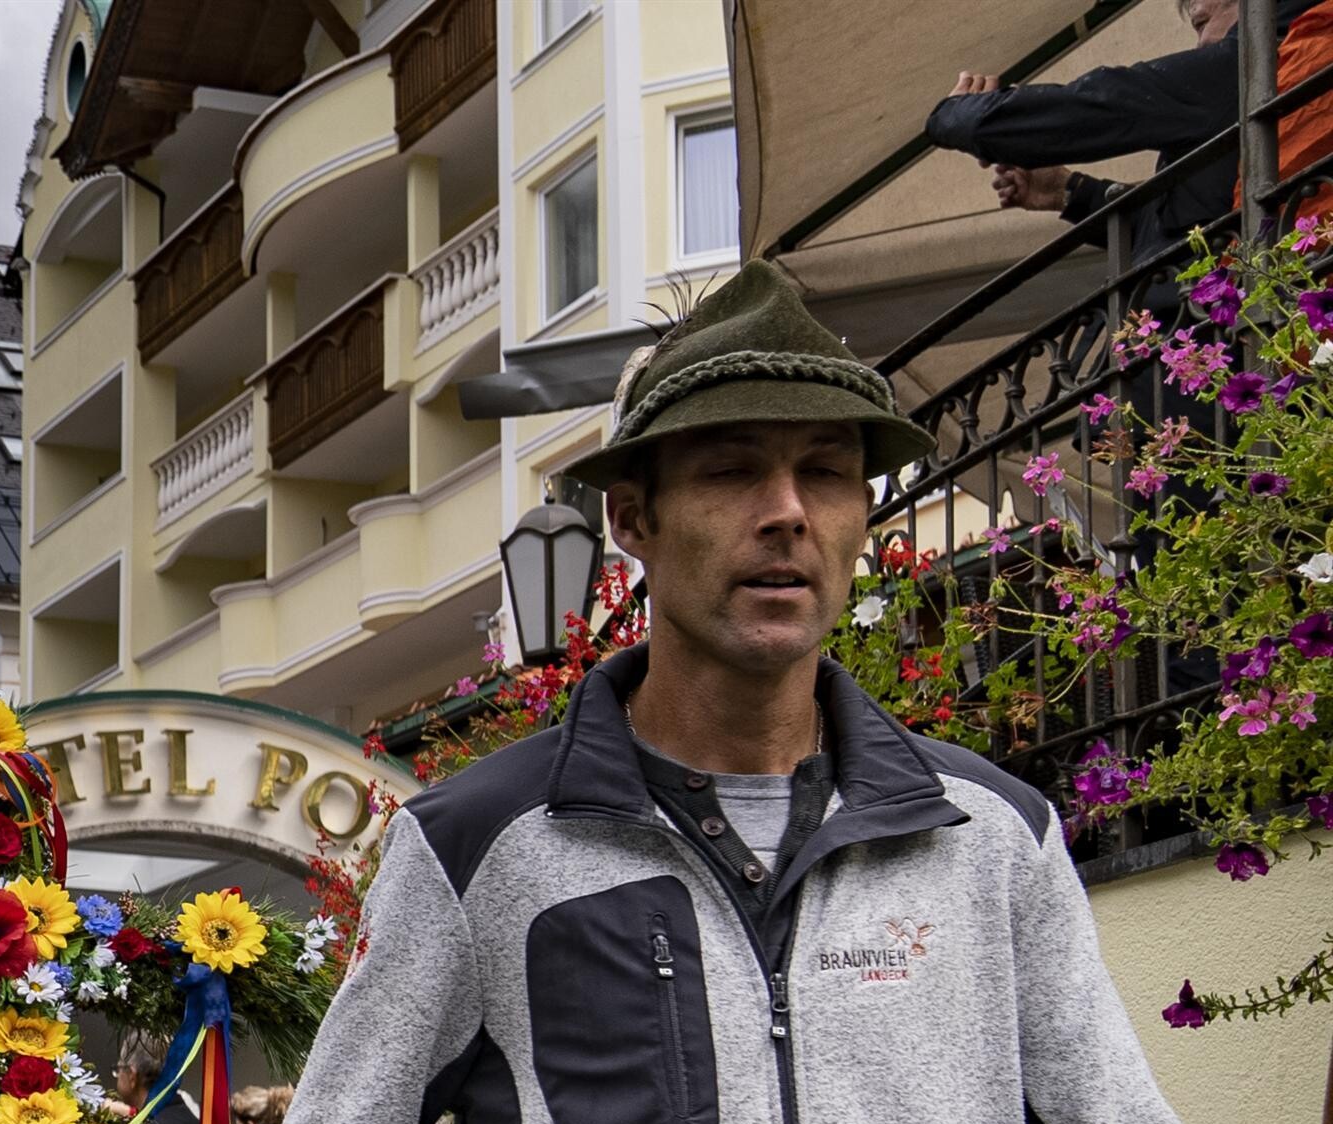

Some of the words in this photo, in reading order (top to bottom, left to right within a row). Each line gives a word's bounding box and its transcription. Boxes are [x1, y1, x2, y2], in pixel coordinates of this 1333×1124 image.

[249, 741, 374, 840] PO
[818, 948, 908, 971] BRAUNVIEH
[860, 968, 909, 982] LANDECK
